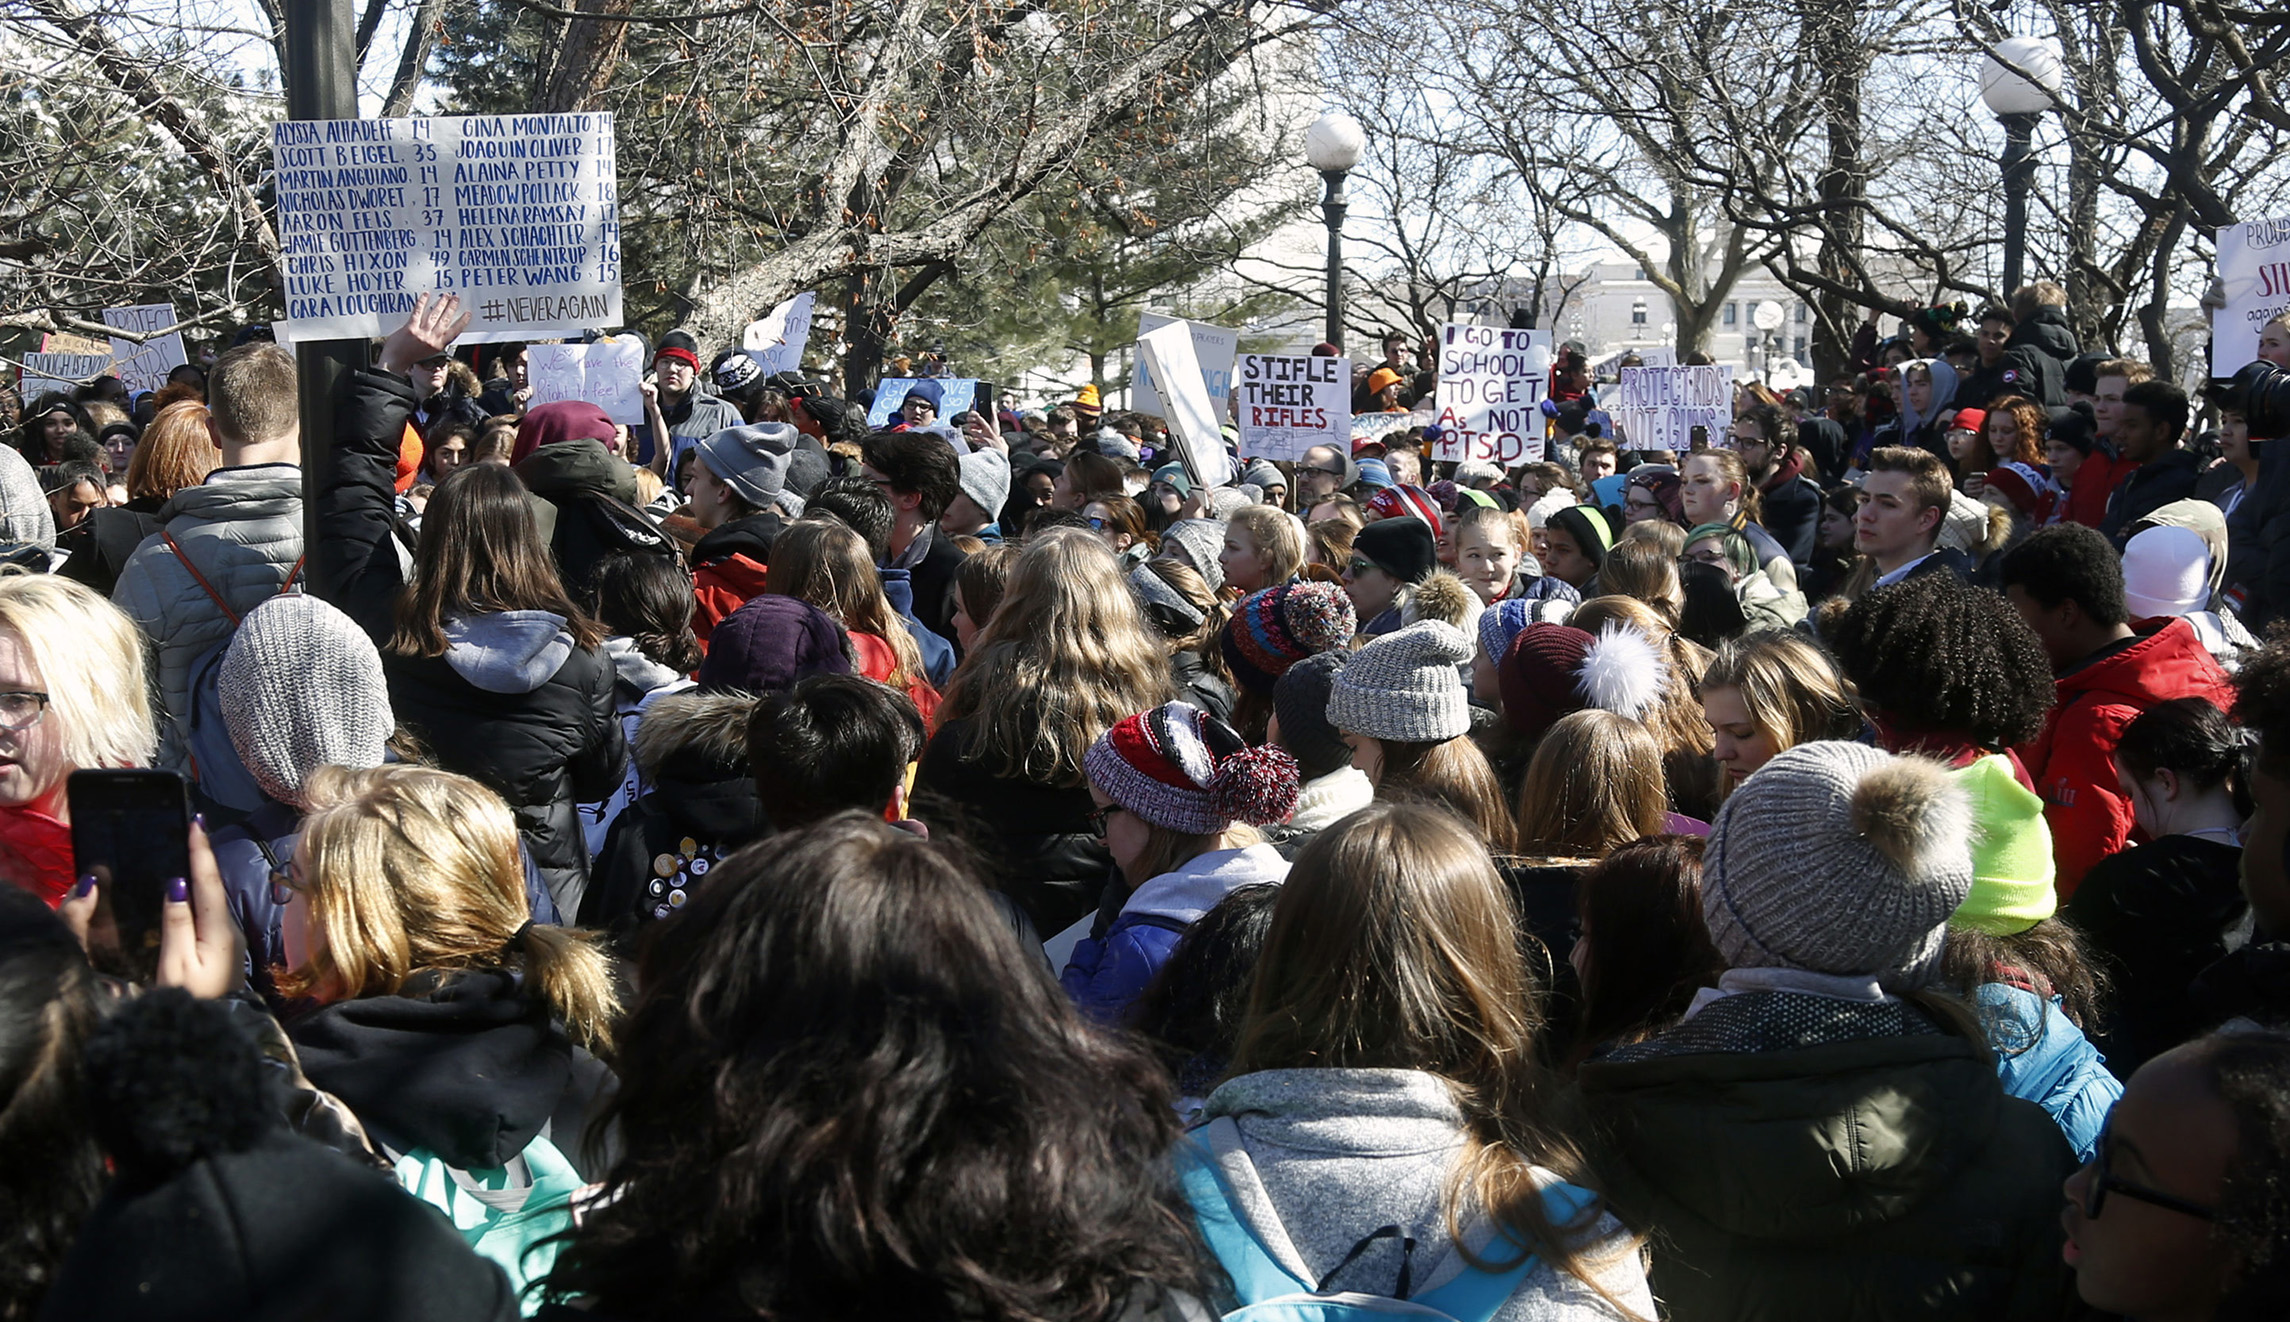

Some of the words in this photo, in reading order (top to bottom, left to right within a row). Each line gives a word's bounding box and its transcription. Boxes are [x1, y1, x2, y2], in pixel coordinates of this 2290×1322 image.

[275, 121, 322, 146] ALYSSA
[411, 119, 431, 140] 14
[462, 117, 506, 138] GINA
[596, 114, 613, 133] 14
[279, 146, 326, 169] SCOTT
[412, 143, 438, 163] 35
[455, 138, 527, 159] JOAQUIN
[596, 136, 613, 156] 17
[278, 169, 334, 191] MARTIN
[419, 165, 438, 185] 14
[454, 161, 521, 183] ALAINA
[596, 159, 612, 177] 14
[277, 189, 346, 213] NICHOLAS
[422, 186, 440, 207] 17
[454, 183, 519, 206] MEADOW
[596, 182, 614, 202] 18
[283, 212, 345, 233] AARON
[421, 209, 445, 226] 37
[458, 206, 521, 226] HELENA
[599, 203, 615, 222] 17
[285, 232, 325, 254] JAMIE
[433, 229, 452, 248] 14
[459, 228, 496, 249] ALEX
[599, 222, 619, 244] 14
[288, 254, 336, 274] CHRIS
[429, 250, 451, 267] 49
[458, 249, 511, 267] CARMEN
[599, 244, 620, 263] 16
[288, 274, 336, 295] LUKE
[433, 269, 454, 290] 15
[461, 267, 520, 288] PETER
[596, 263, 617, 283] 15
[290, 295, 334, 319] CARA
[480, 293, 609, 323] #NEVERAGAIN
[2247, 303, 2290, 335] agains
[1446, 326, 1456, 345] I
[1465, 327, 1493, 347] GO
[1501, 331, 1531, 351] TO
[531, 347, 566, 371] We
[614, 356, 633, 369] the
[1243, 355, 1338, 384] STIFLE
[1444, 350, 1538, 377] SCHOOL
[536, 378, 568, 403] Right
[576, 383, 588, 398] to
[593, 381, 620, 398] feel
[1243, 382, 1315, 407] THEIR
[1442, 378, 1475, 404] TO
[1482, 378, 1544, 404] GET
[1620, 366, 1691, 408] PROTECT
[1693, 366, 1725, 408] KIDS
[1251, 406, 1328, 430] RIFLES
[1487, 407, 1535, 433] NOT
[1620, 407, 1659, 451] NOT
[1435, 429, 1523, 462] PTSD
